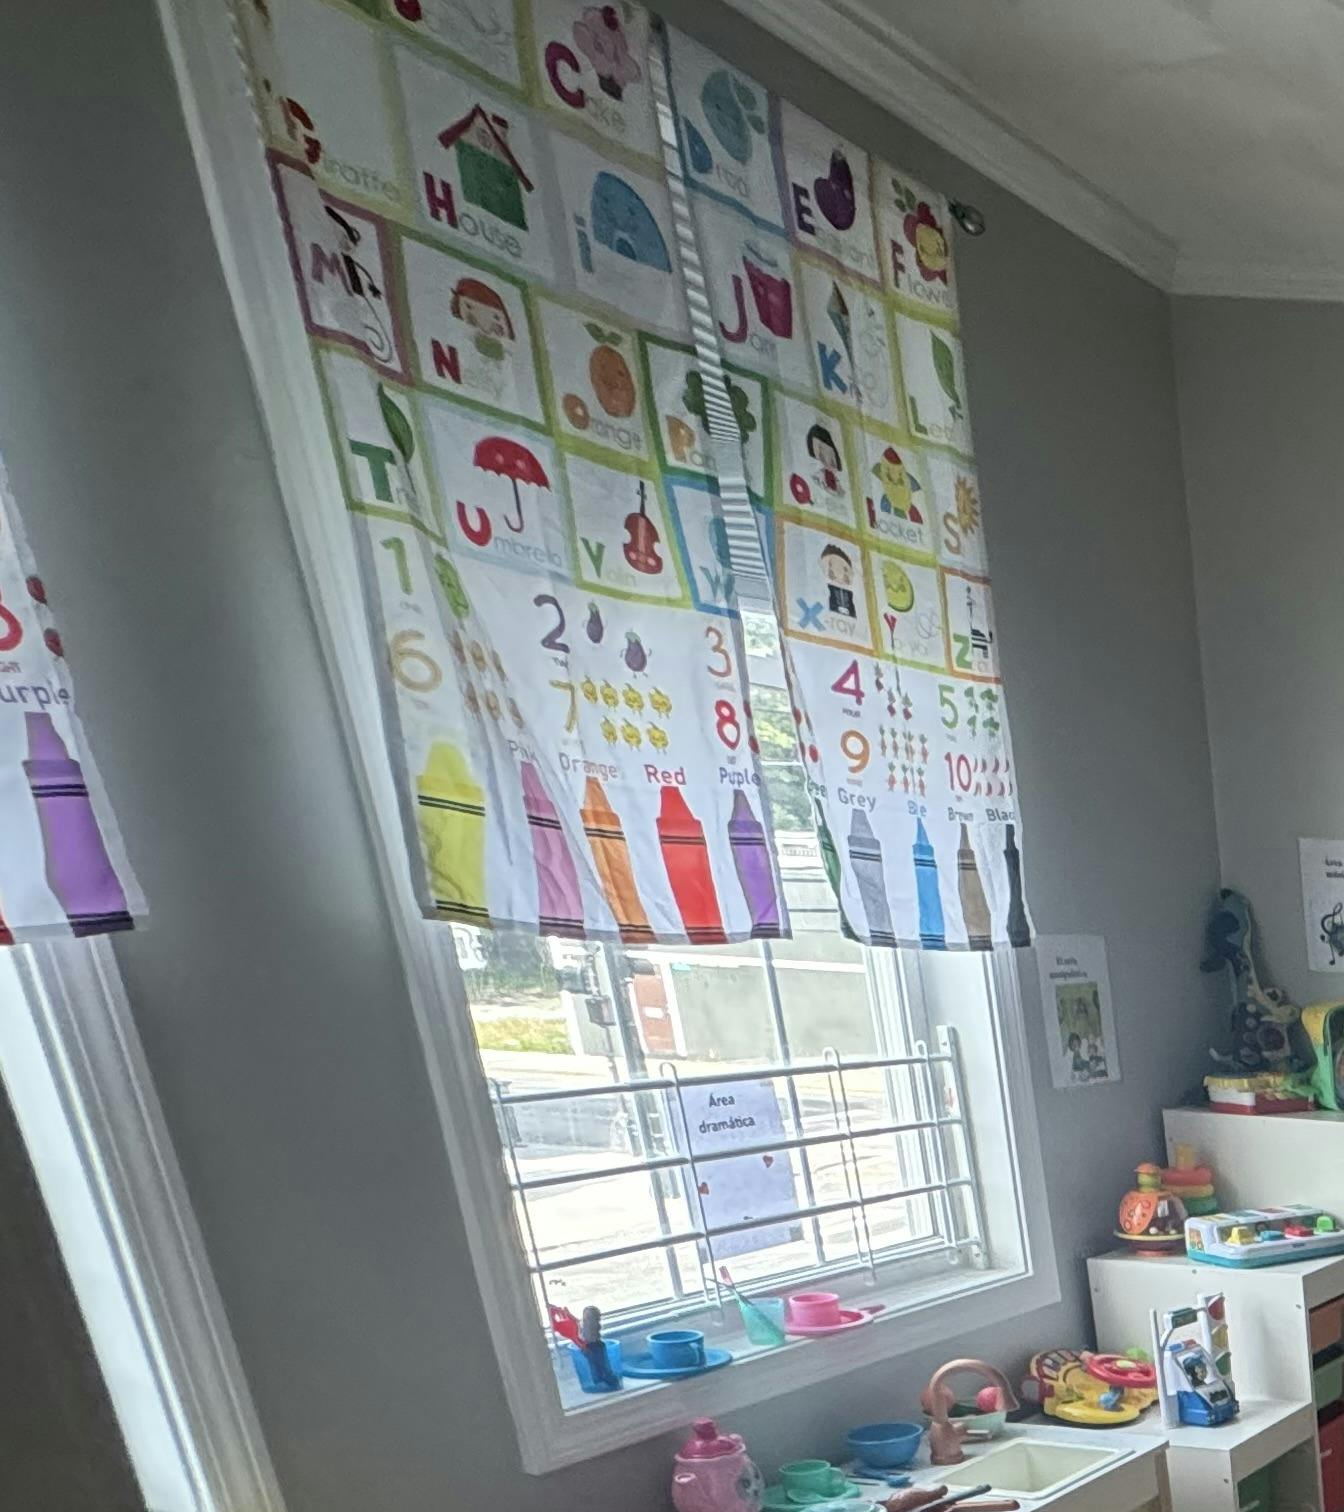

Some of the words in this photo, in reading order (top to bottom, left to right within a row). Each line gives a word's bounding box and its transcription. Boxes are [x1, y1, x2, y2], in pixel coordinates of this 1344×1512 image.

[532, 593, 571, 654] 2
[390, 629, 443, 693] 6
[705, 625, 733, 679] 3
[0, 679, 71, 710] urple
[830, 659, 865, 706] 4
[548, 679, 577, 734] 7
[714, 699, 741, 752] 8
[938, 684, 960, 730] 5
[558, 752, 618, 780] Orange
[643, 763, 688, 786] Red
[840, 729, 871, 775] 9
[944, 751, 973, 793] 10
[837, 787, 877, 812] Grey
[708, 1093, 736, 1108] Área
[698, 1115, 756, 1134] dramática
